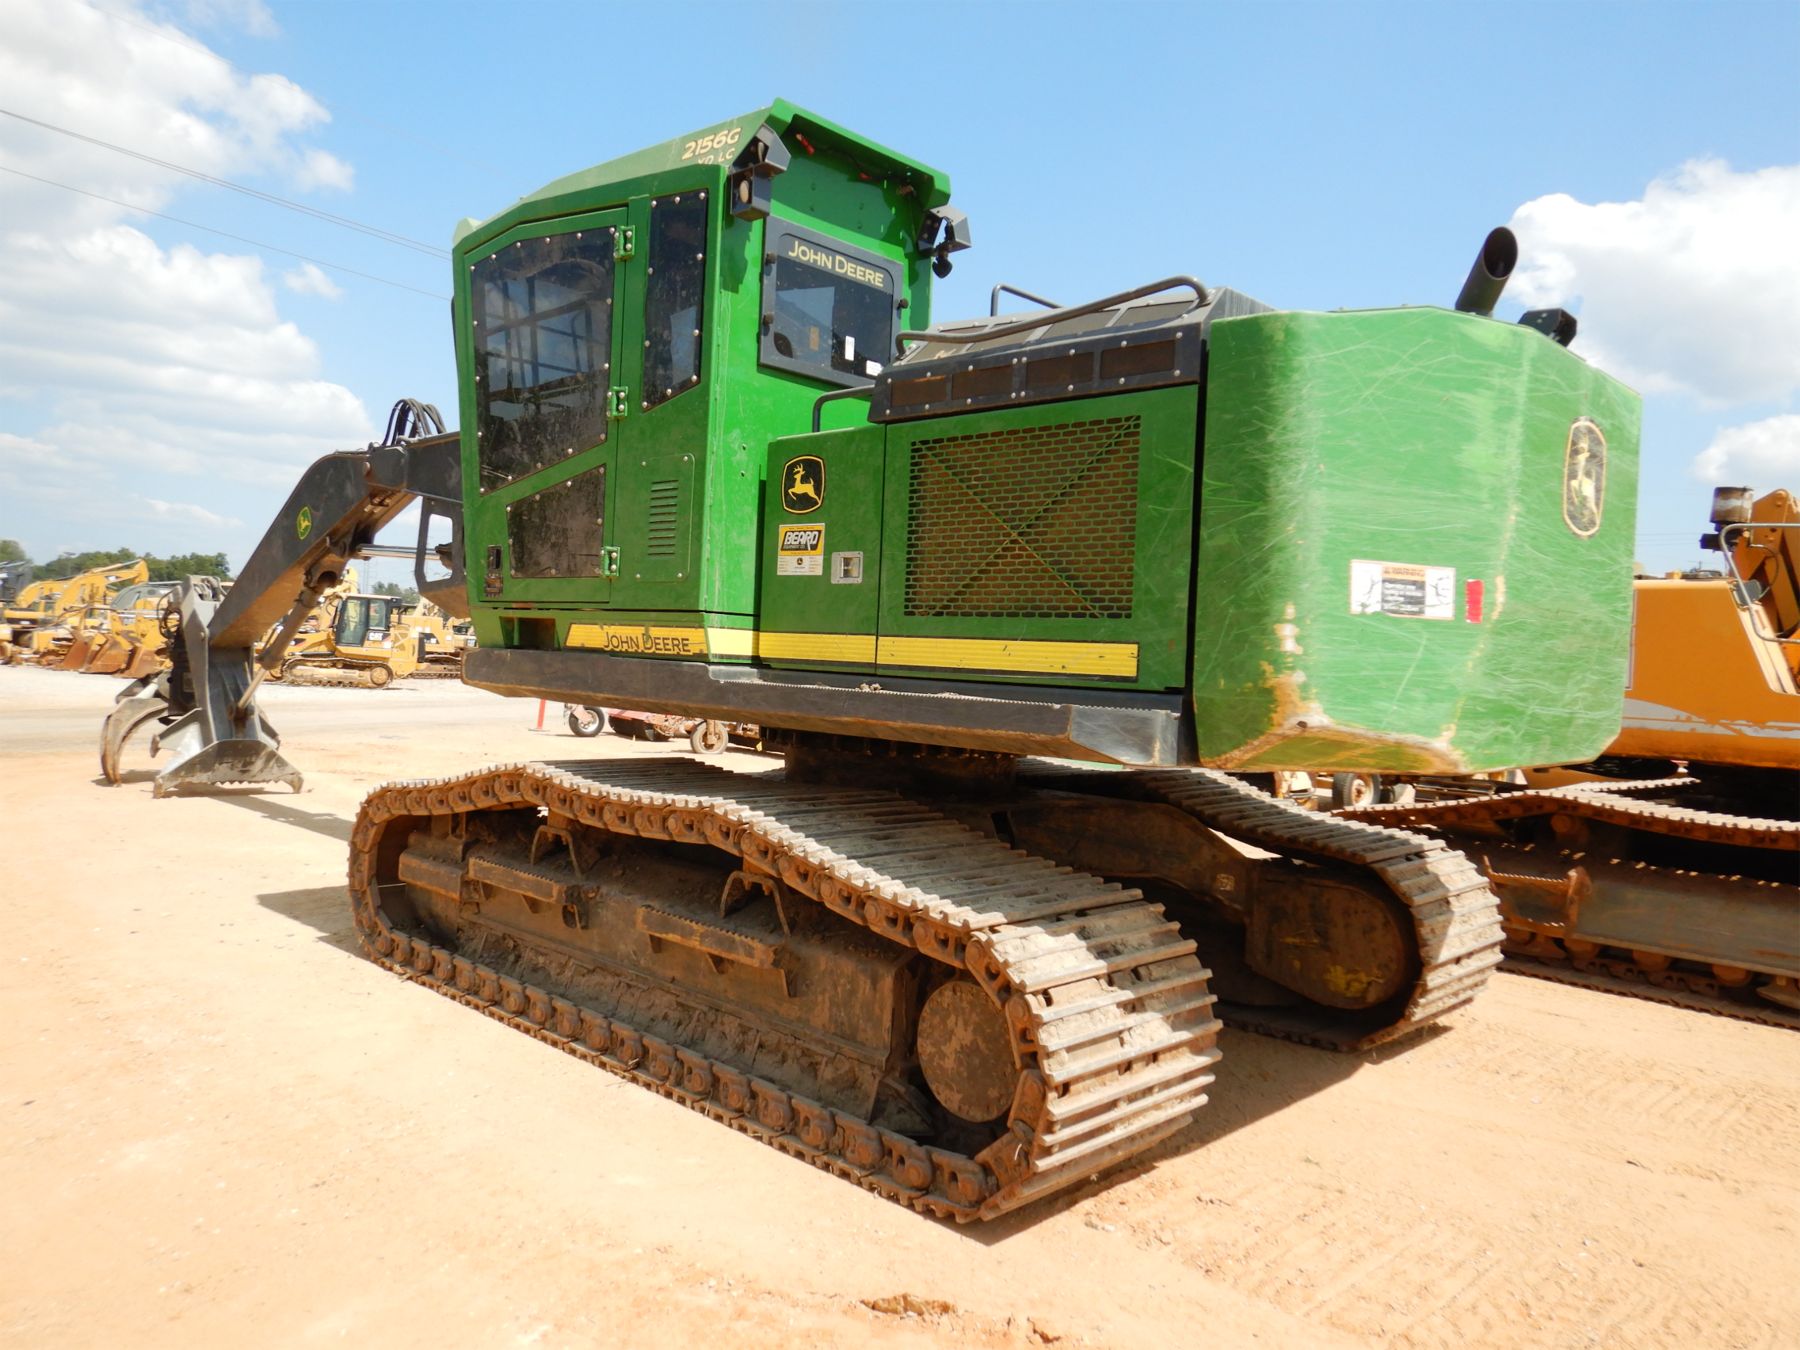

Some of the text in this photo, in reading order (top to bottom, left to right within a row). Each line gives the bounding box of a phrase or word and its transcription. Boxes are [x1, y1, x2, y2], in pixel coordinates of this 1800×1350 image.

[682, 127, 741, 160] 2156G
[718, 148, 735, 162] LC
[788, 240, 884, 288] JOHN DEERE
[784, 531, 819, 550] BEARD
[603, 631, 691, 653] JOHN DEERE
